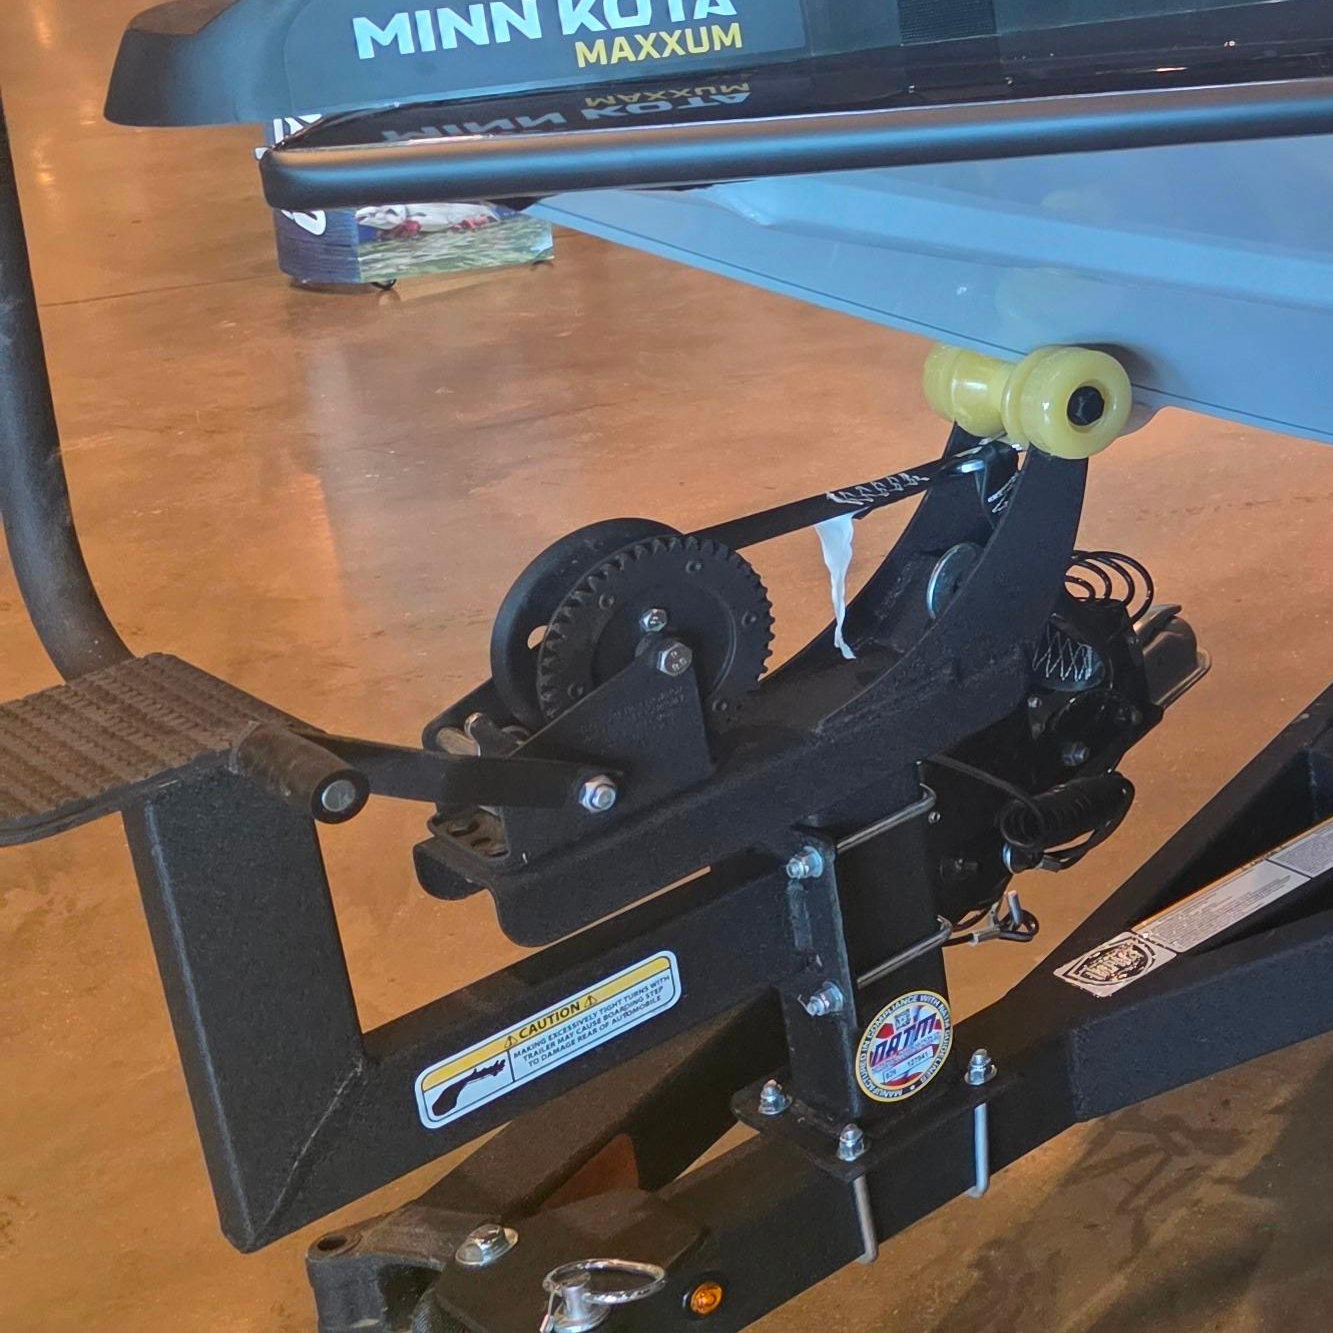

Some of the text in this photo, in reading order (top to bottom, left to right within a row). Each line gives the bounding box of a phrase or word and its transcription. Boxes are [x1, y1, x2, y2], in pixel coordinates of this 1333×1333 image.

[574, 22, 743, 68] MAXXUM
[513, 975, 671, 1060] MAKING EXCESSIVELY TIGHT TURNS WITH
[518, 1001, 581, 1040] CAUTION
[522, 985, 665, 1063] TRAILER MAY CAUSE BOARDING STEP
[527, 995, 662, 1068] TO DAMAGE REAR OF AUTOMOBILE
[866, 994, 919, 1040] COMPLIANCE
[920, 993, 941, 1007] WITH
